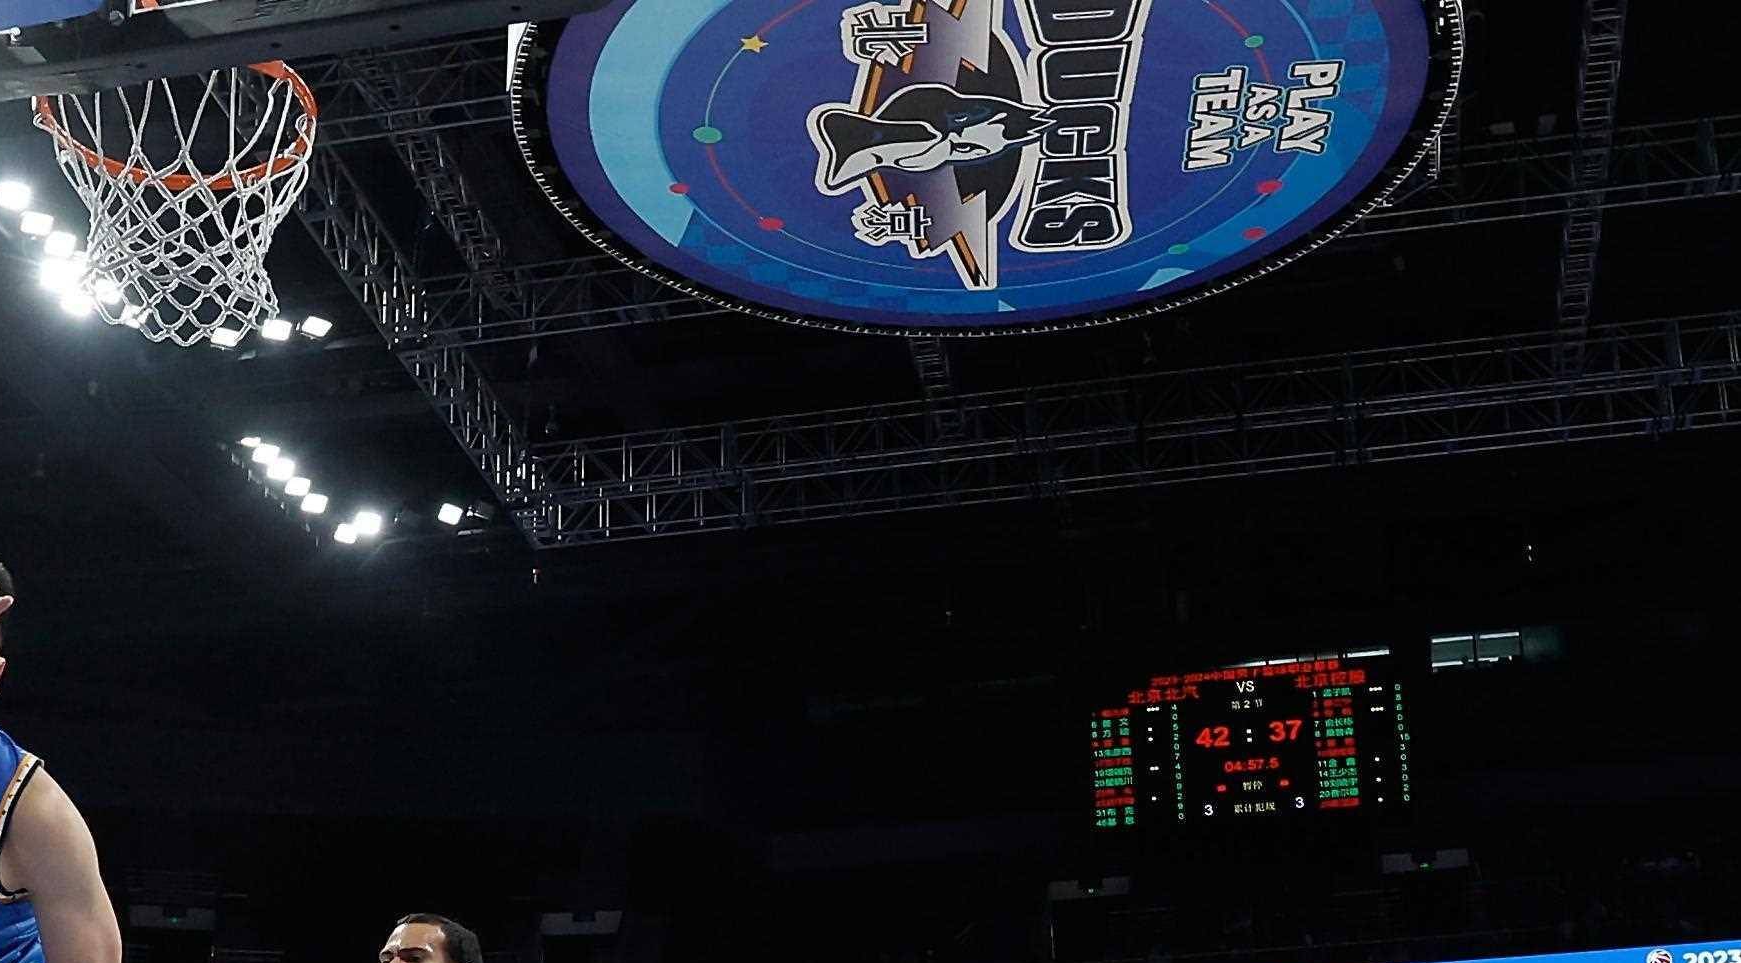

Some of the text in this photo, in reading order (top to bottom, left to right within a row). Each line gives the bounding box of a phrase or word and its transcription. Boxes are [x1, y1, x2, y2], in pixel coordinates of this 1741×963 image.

[1023, 0, 1135, 247] DUCKS
[1183, 66, 1245, 171] TEAM
[1238, 84, 1282, 148] AS A
[1279, 61, 1344, 155] PLAY
[1236, 680, 1255, 693] VS
[1195, 726, 1232, 747] 42
[1268, 720, 1303, 742] 37
[1204, 804, 1214, 816] 3
[1295, 796, 1305, 808] 3
